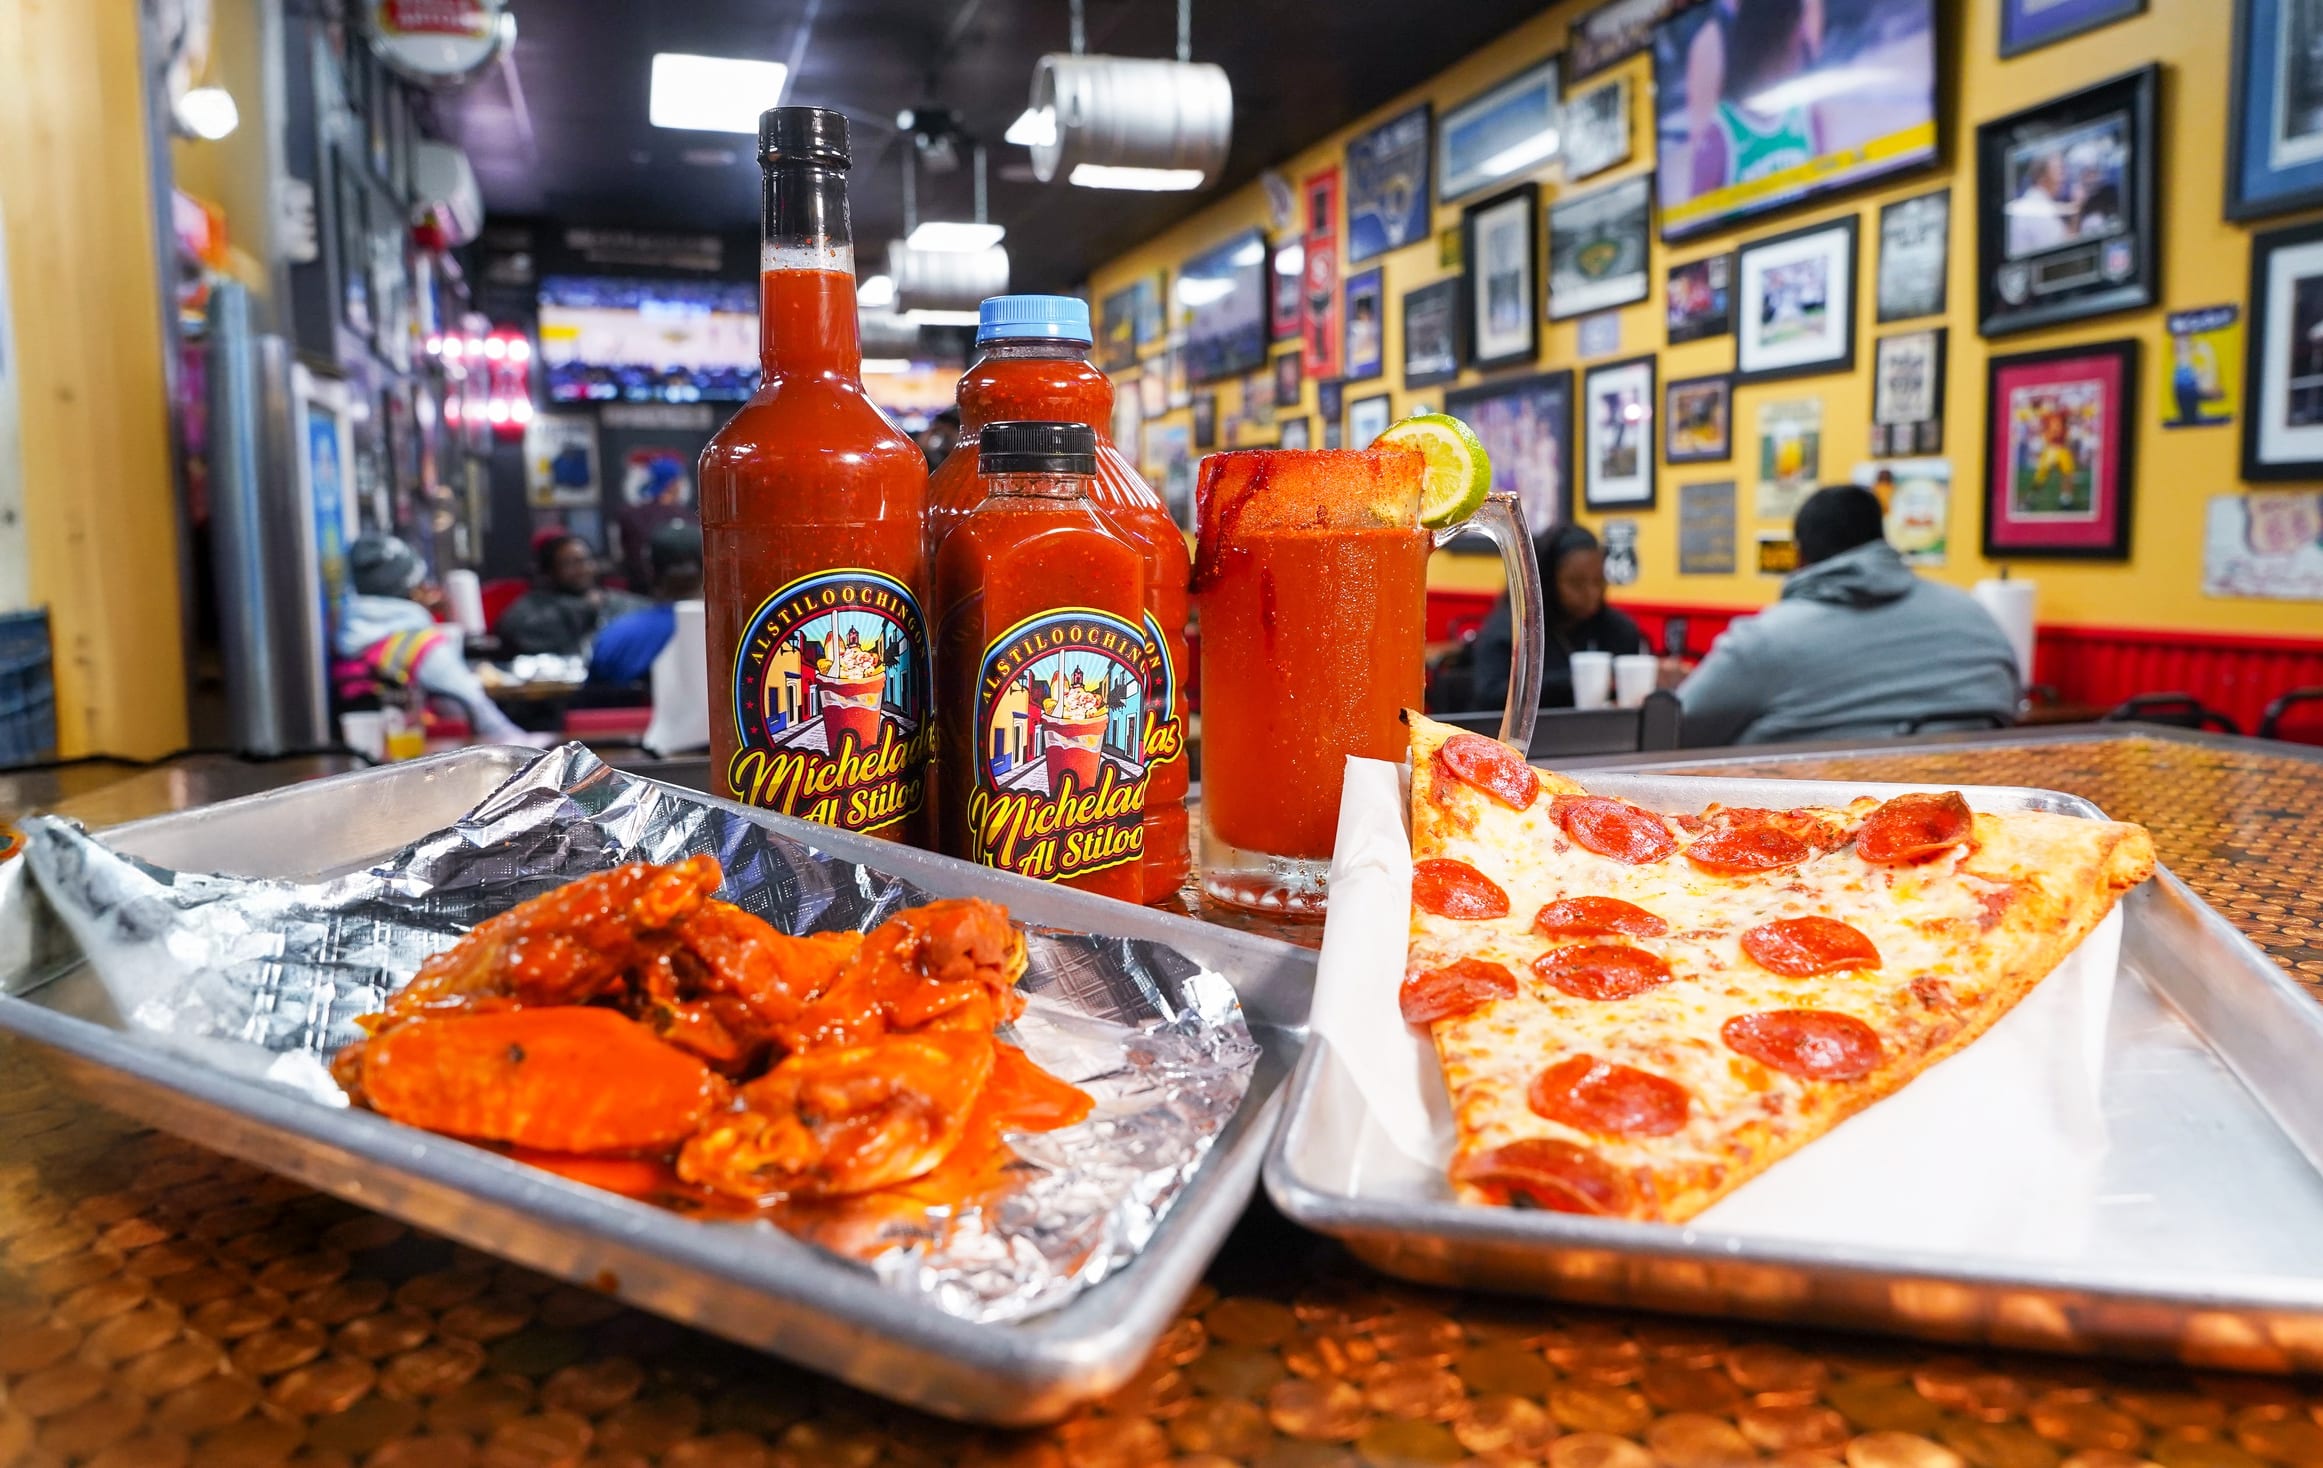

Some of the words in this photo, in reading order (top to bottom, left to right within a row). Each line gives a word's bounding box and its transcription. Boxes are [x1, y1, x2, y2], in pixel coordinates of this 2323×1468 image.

[802, 800, 841, 828] Al
[846, 778, 921, 824] Stiloo
[1020, 838, 1057, 877] Al
[1062, 826, 1144, 867] Stiloo
